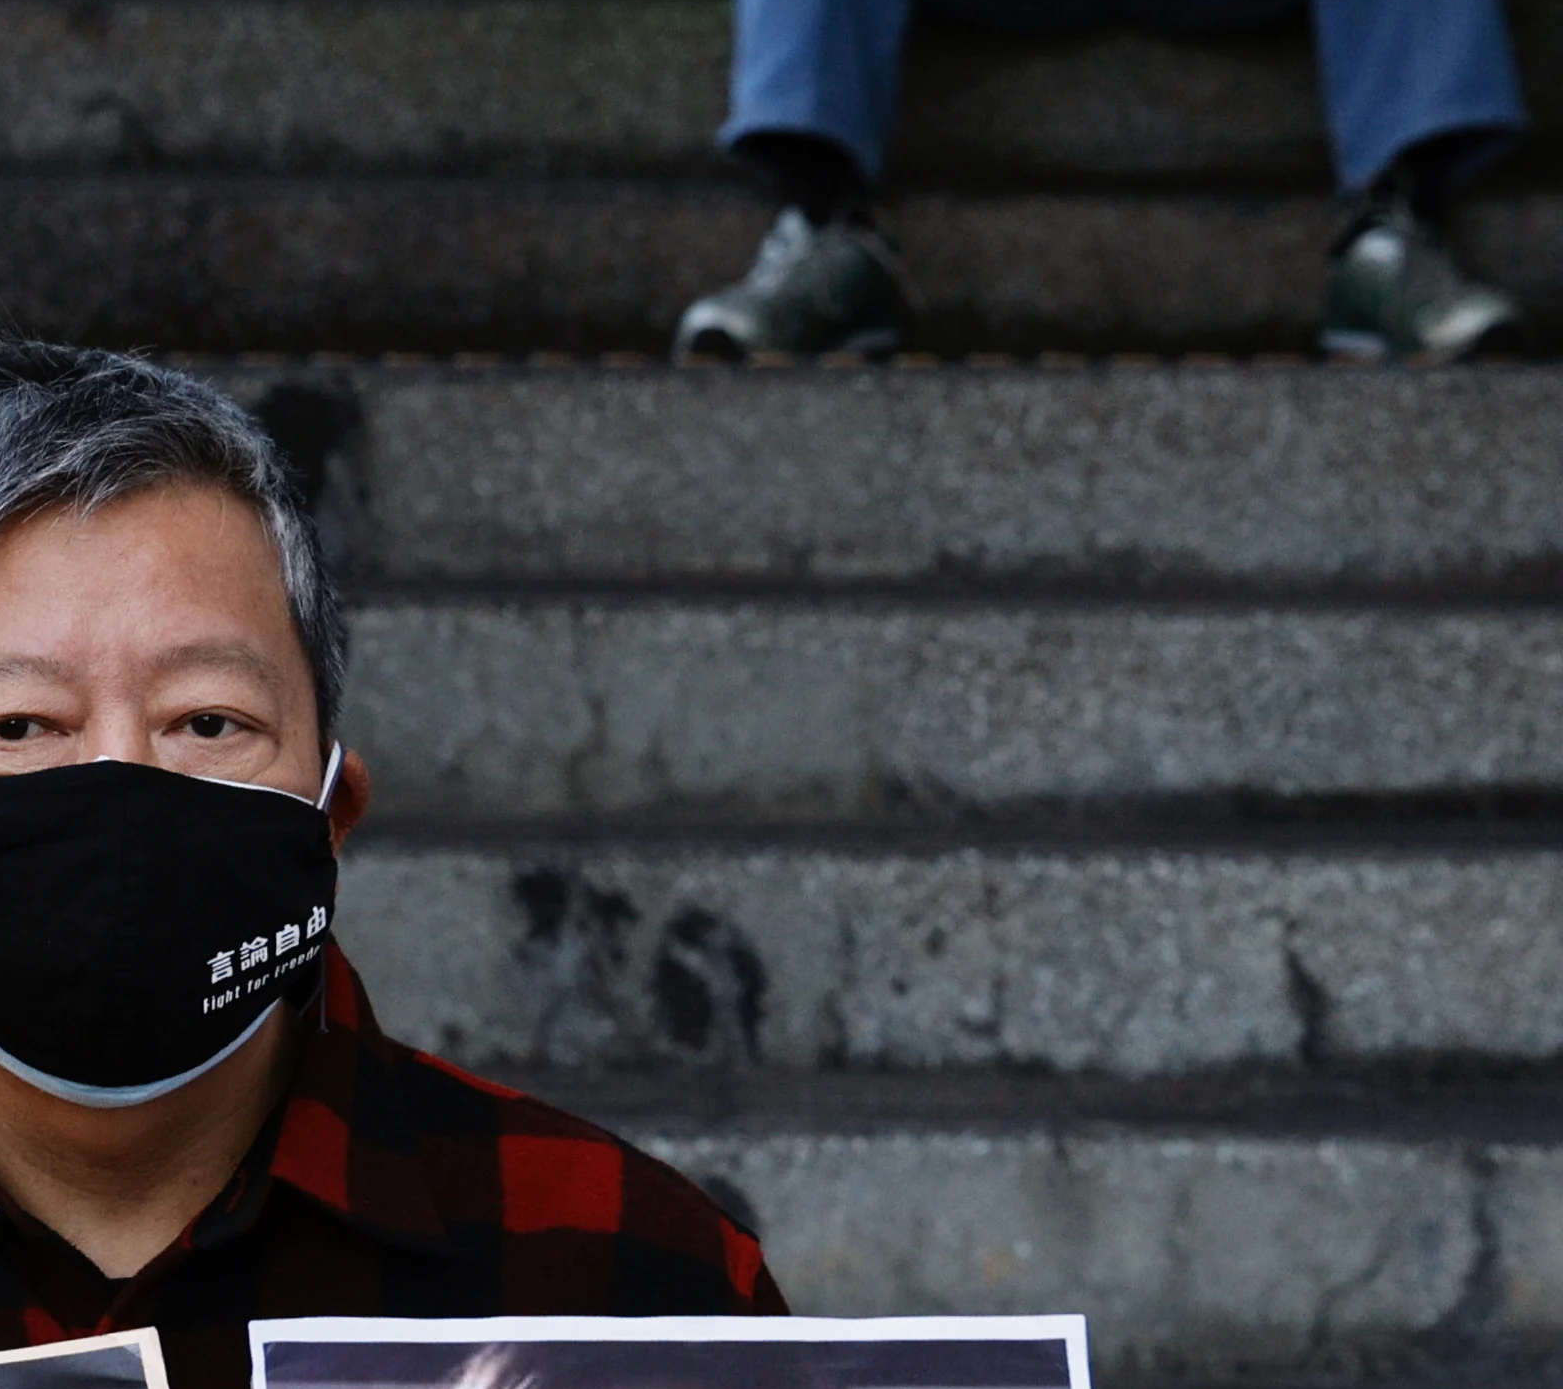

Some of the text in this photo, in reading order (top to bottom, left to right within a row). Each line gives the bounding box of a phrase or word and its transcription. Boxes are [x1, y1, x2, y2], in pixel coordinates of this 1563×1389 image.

[206, 905, 327, 985] 言論自由
[246, 973, 271, 994] for
